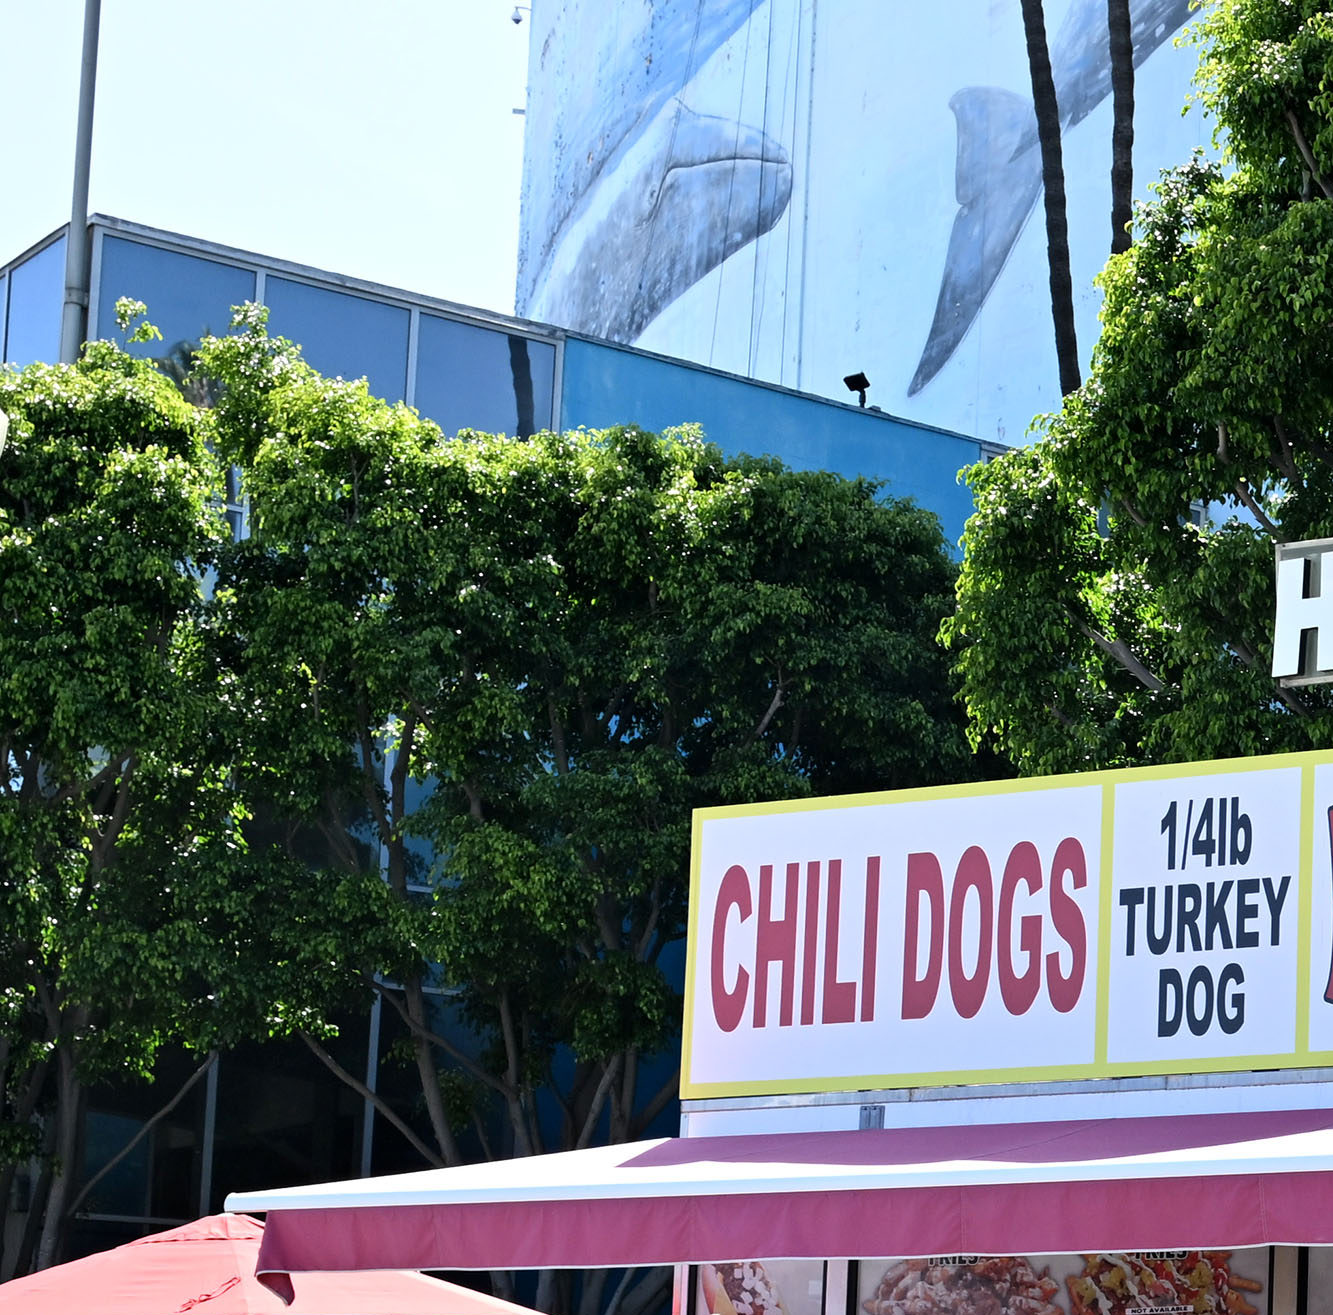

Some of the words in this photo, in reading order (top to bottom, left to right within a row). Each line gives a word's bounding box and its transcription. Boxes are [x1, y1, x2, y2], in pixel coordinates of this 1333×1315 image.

[1160, 796, 1253, 871] 1/4lb
[710, 864, 881, 1033] CHILI
[900, 836, 1088, 1020] DOGS
[1119, 875, 1291, 957] TURKEY
[1157, 963, 1245, 1038] DOG
[1149, 1305, 1188, 1313] AVAILABLE
